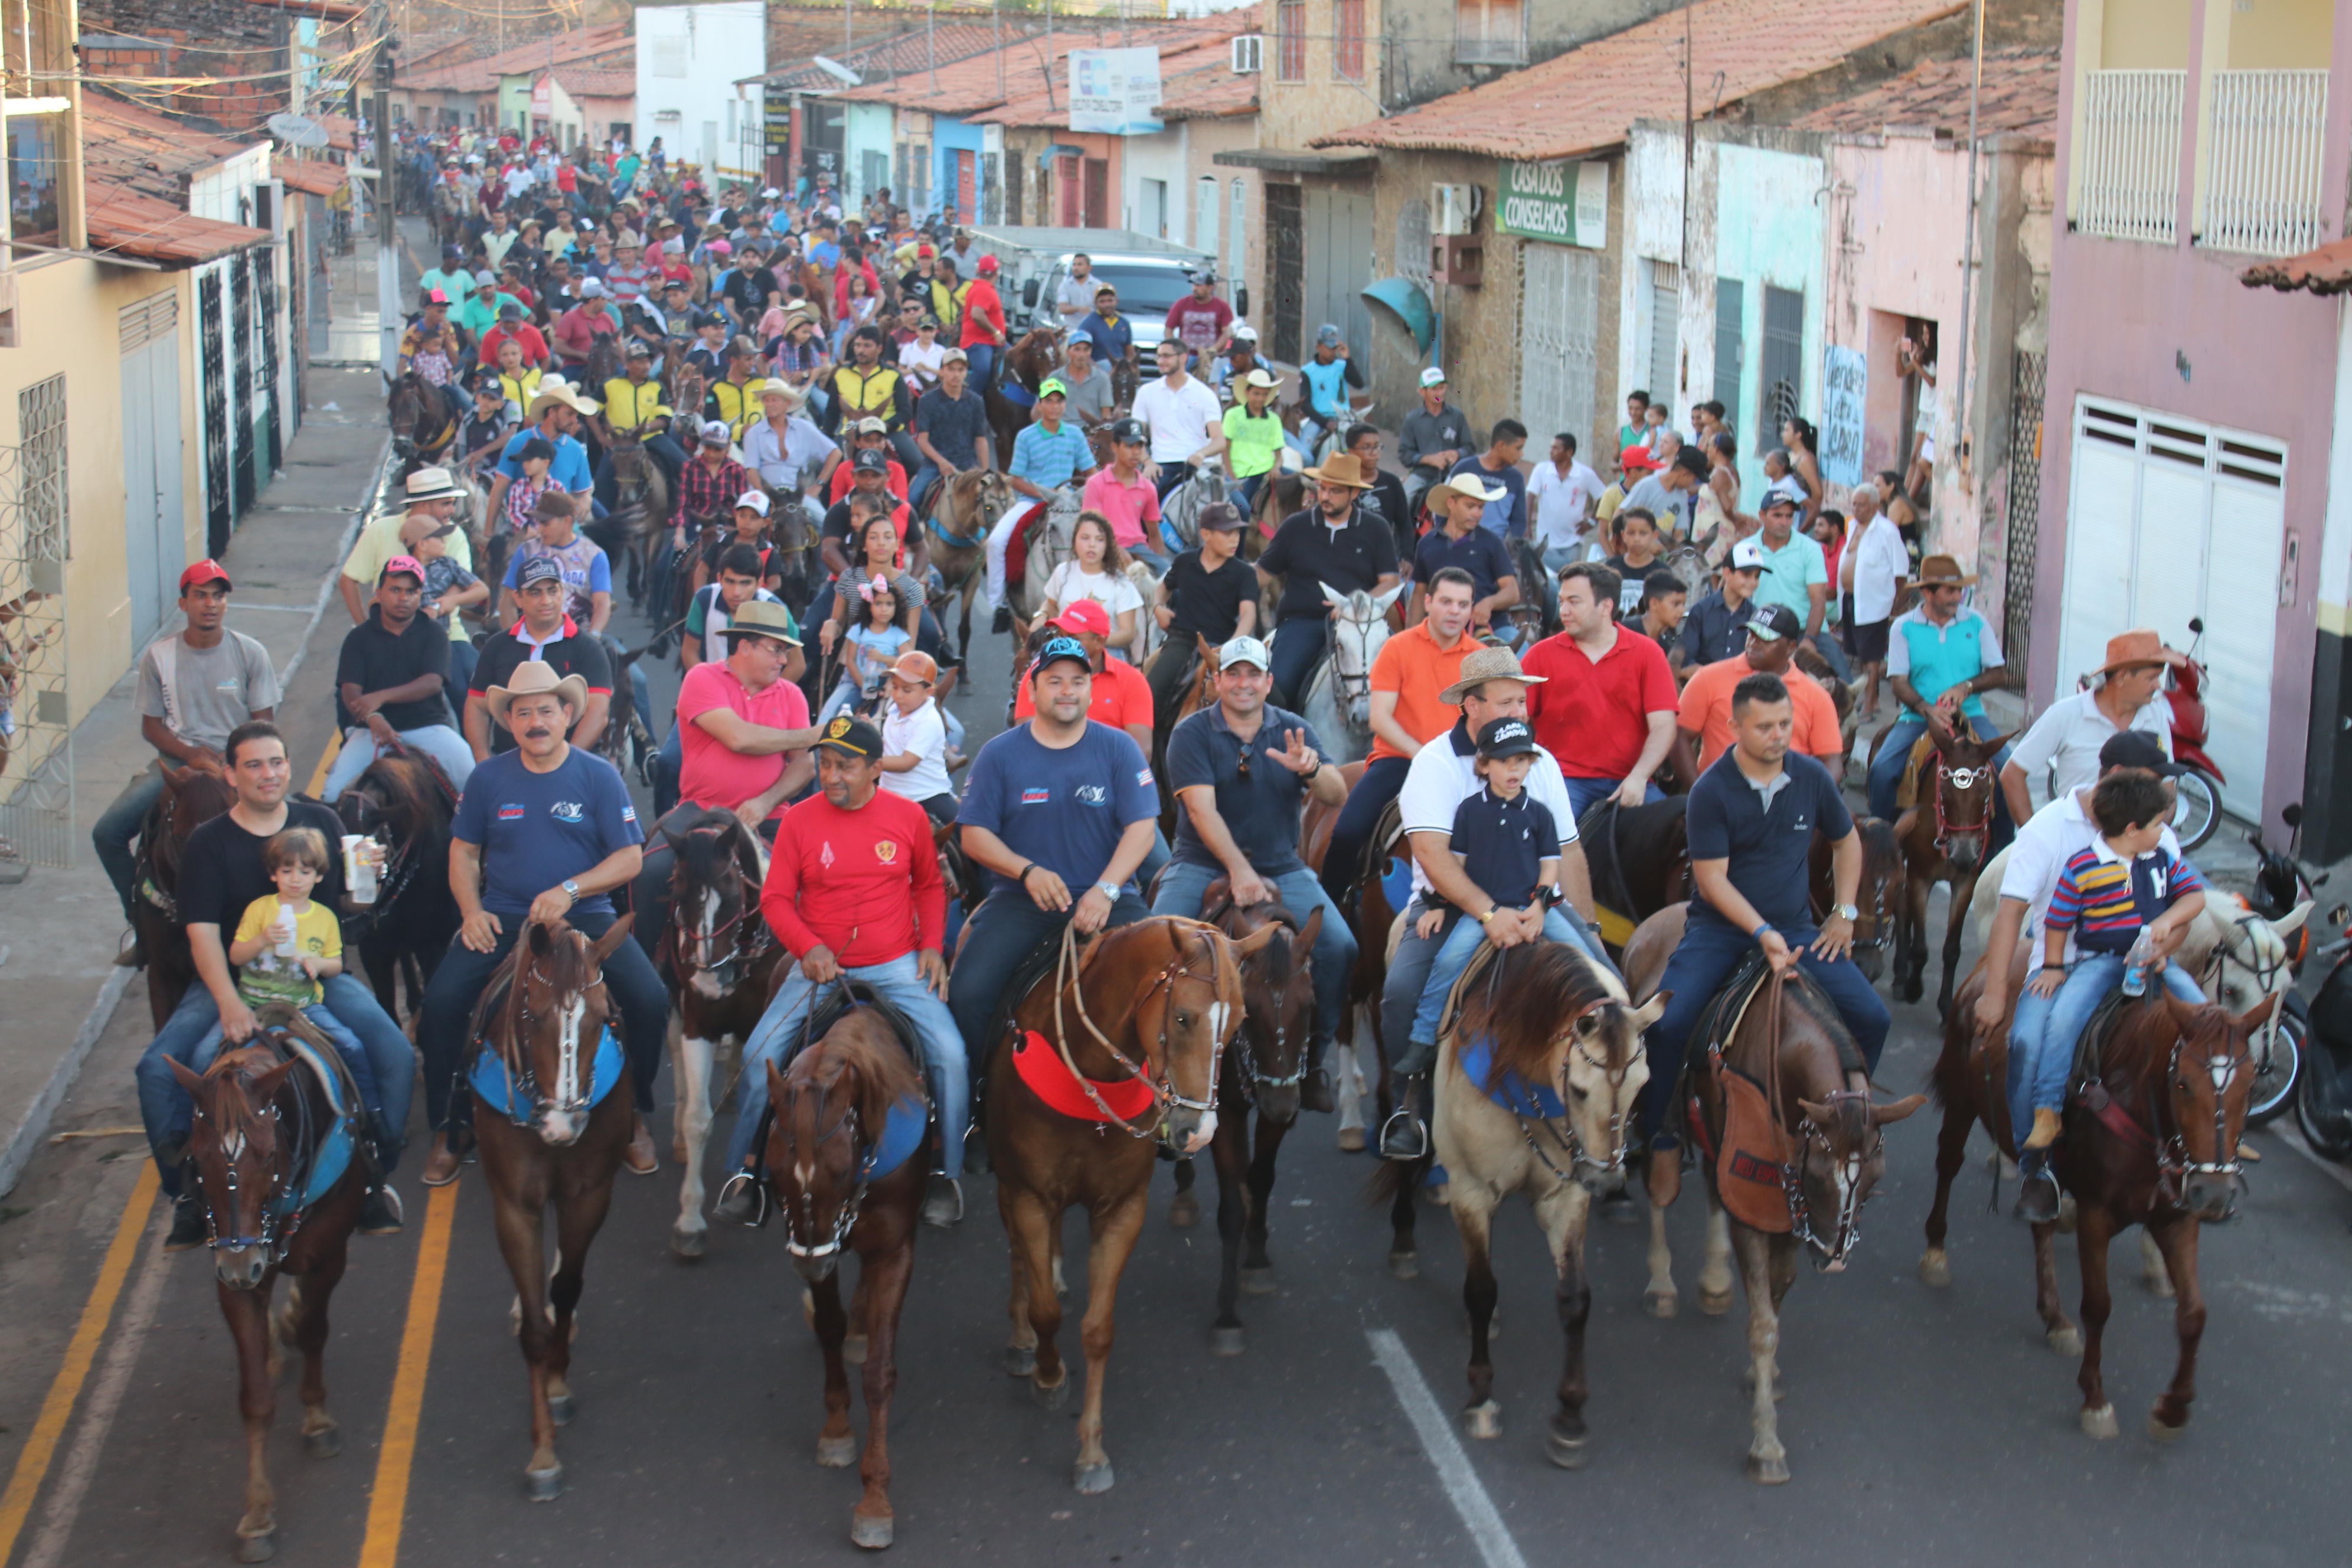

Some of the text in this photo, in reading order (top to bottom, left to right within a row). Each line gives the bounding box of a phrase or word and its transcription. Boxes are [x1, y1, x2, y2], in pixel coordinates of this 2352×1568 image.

[1511, 161, 1564, 197] CASA DOS
[1505, 196, 1569, 236] CONSELHOS
[1022, 792, 1049, 801] Louro
[498, 808, 524, 817] Louro
[2150, 866, 2167, 899] H
[1734, 1155, 1756, 1178] MEU
